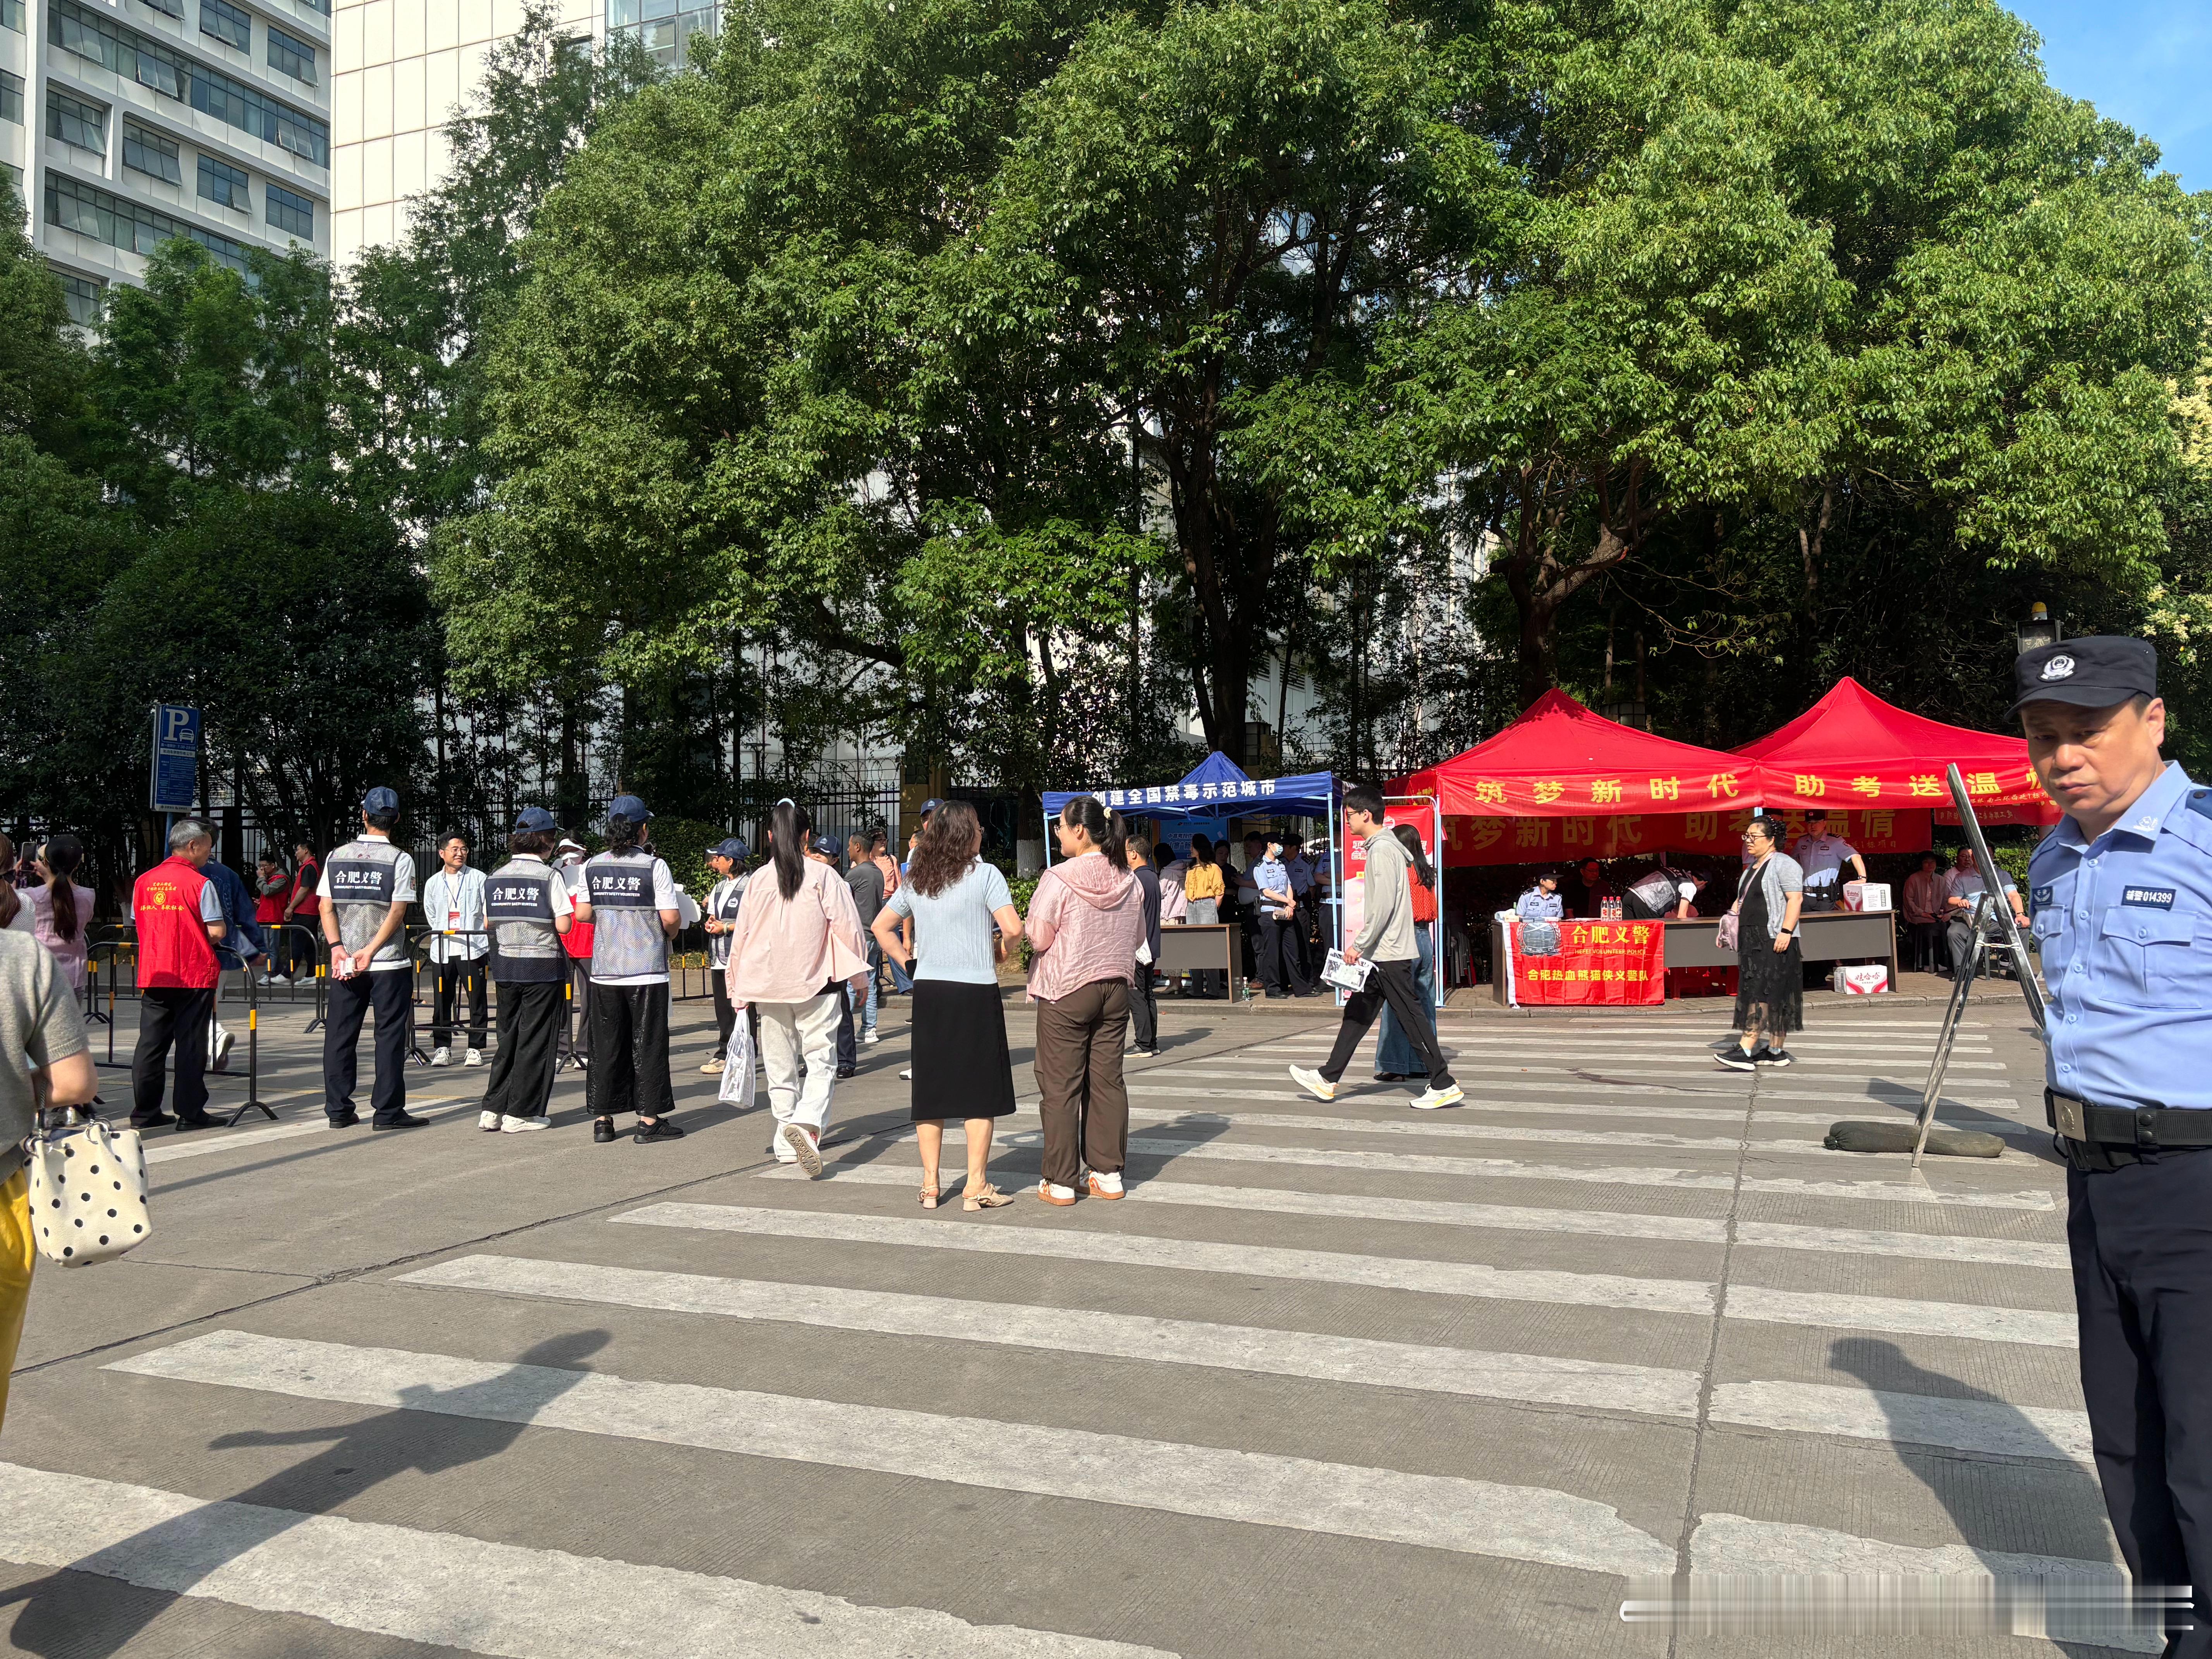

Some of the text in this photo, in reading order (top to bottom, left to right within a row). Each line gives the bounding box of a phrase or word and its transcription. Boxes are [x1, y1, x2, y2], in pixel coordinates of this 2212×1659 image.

[164, 708, 189, 741] P
[1091, 779, 1276, 807] 创建全国禁毒示范城市
[1474, 774, 1739, 805] 筑梦新时代
[335, 870, 382, 884] 合肥义警
[592, 876, 641, 891] 合肥义警
[492, 887, 539, 901] 合肥义警
[1571, 926, 1650, 945] 合肥义警
[1527, 969, 1649, 981] 合肥热血熊猫侠义警队
[1855, 972, 1881, 981] 娃哈哈
